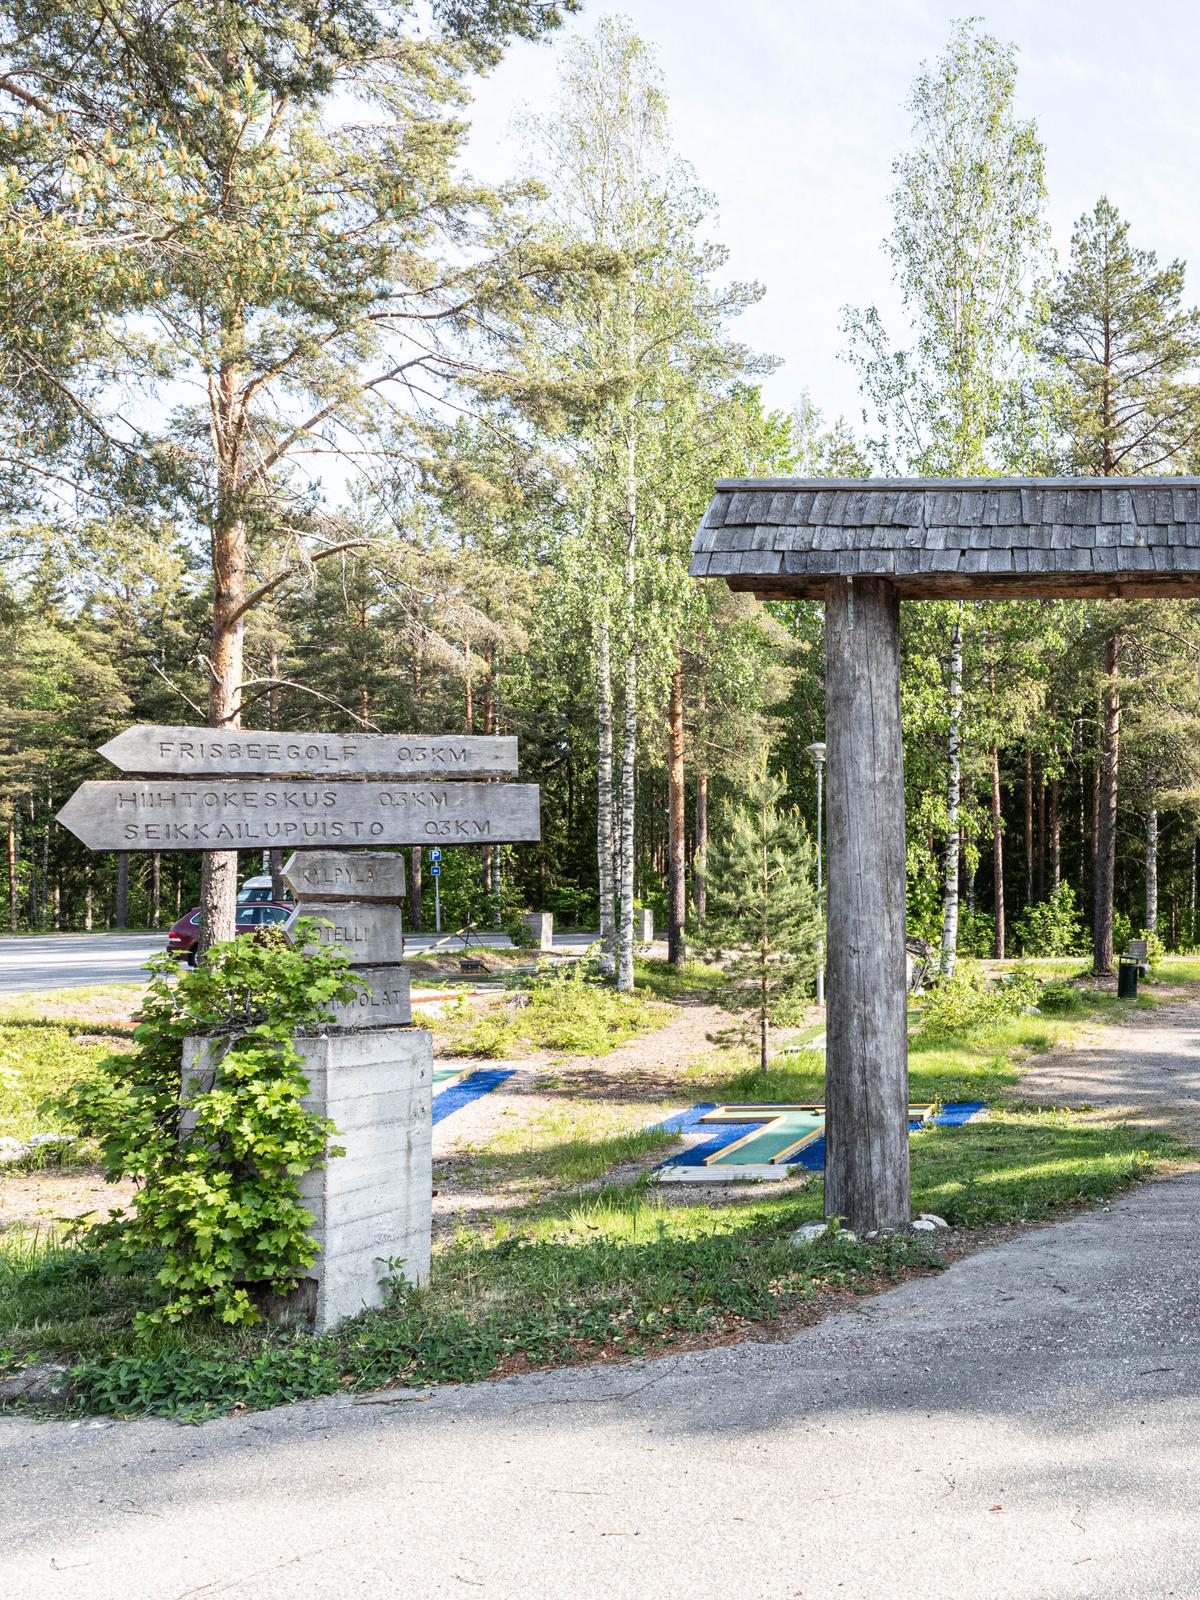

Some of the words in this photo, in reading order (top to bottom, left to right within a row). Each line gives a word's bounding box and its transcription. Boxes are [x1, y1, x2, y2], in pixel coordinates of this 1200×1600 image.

[159, 741, 357, 761] FRISBEEGOLF
[118, 791, 337, 809] HIIHTOKESKUS
[124, 821, 384, 840] SEIKKAILUPUISTO
